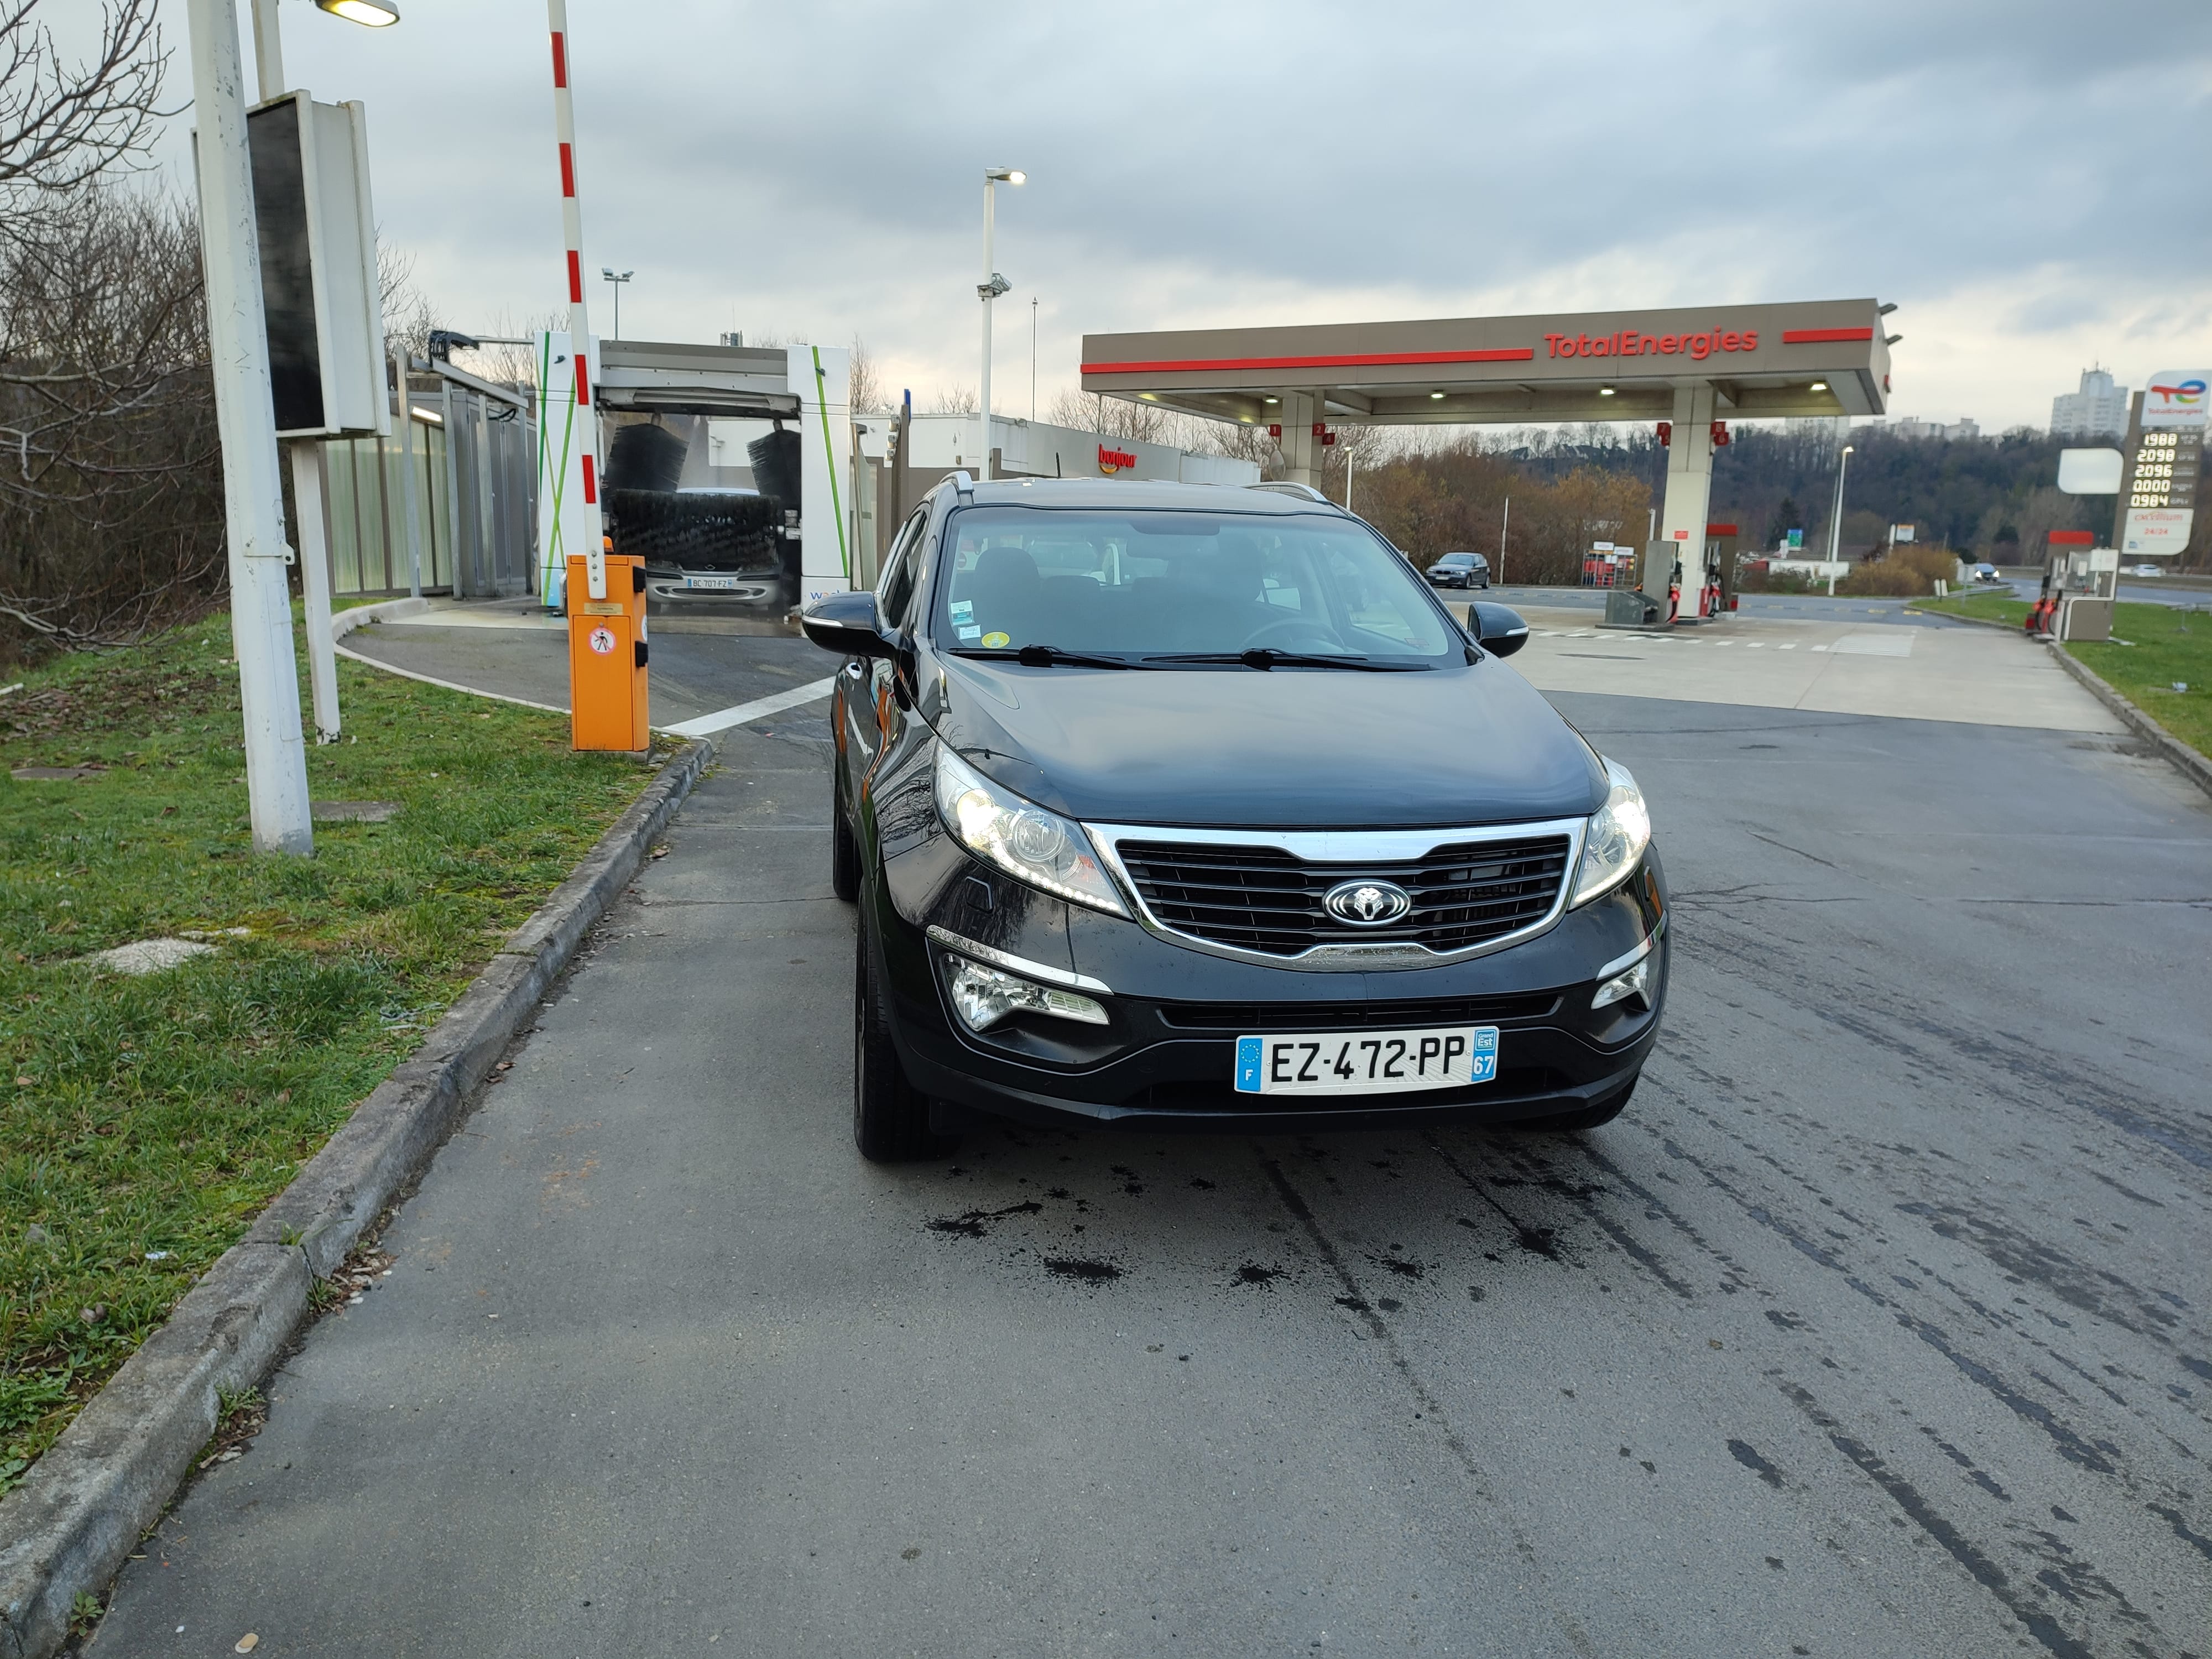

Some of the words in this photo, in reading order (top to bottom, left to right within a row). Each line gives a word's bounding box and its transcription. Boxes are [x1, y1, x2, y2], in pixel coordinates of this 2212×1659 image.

[1545, 325, 1758, 359] TotalEnergies
[1316, 425, 1321, 434] 2
[1099, 443, 1137, 471] bonjour
[1478, 1038, 1493, 1046] Est
[1271, 1035, 1465, 1082] EZ-472-PP
[1474, 1055, 1494, 1074] 67
[1245, 1069, 1254, 1081] F
